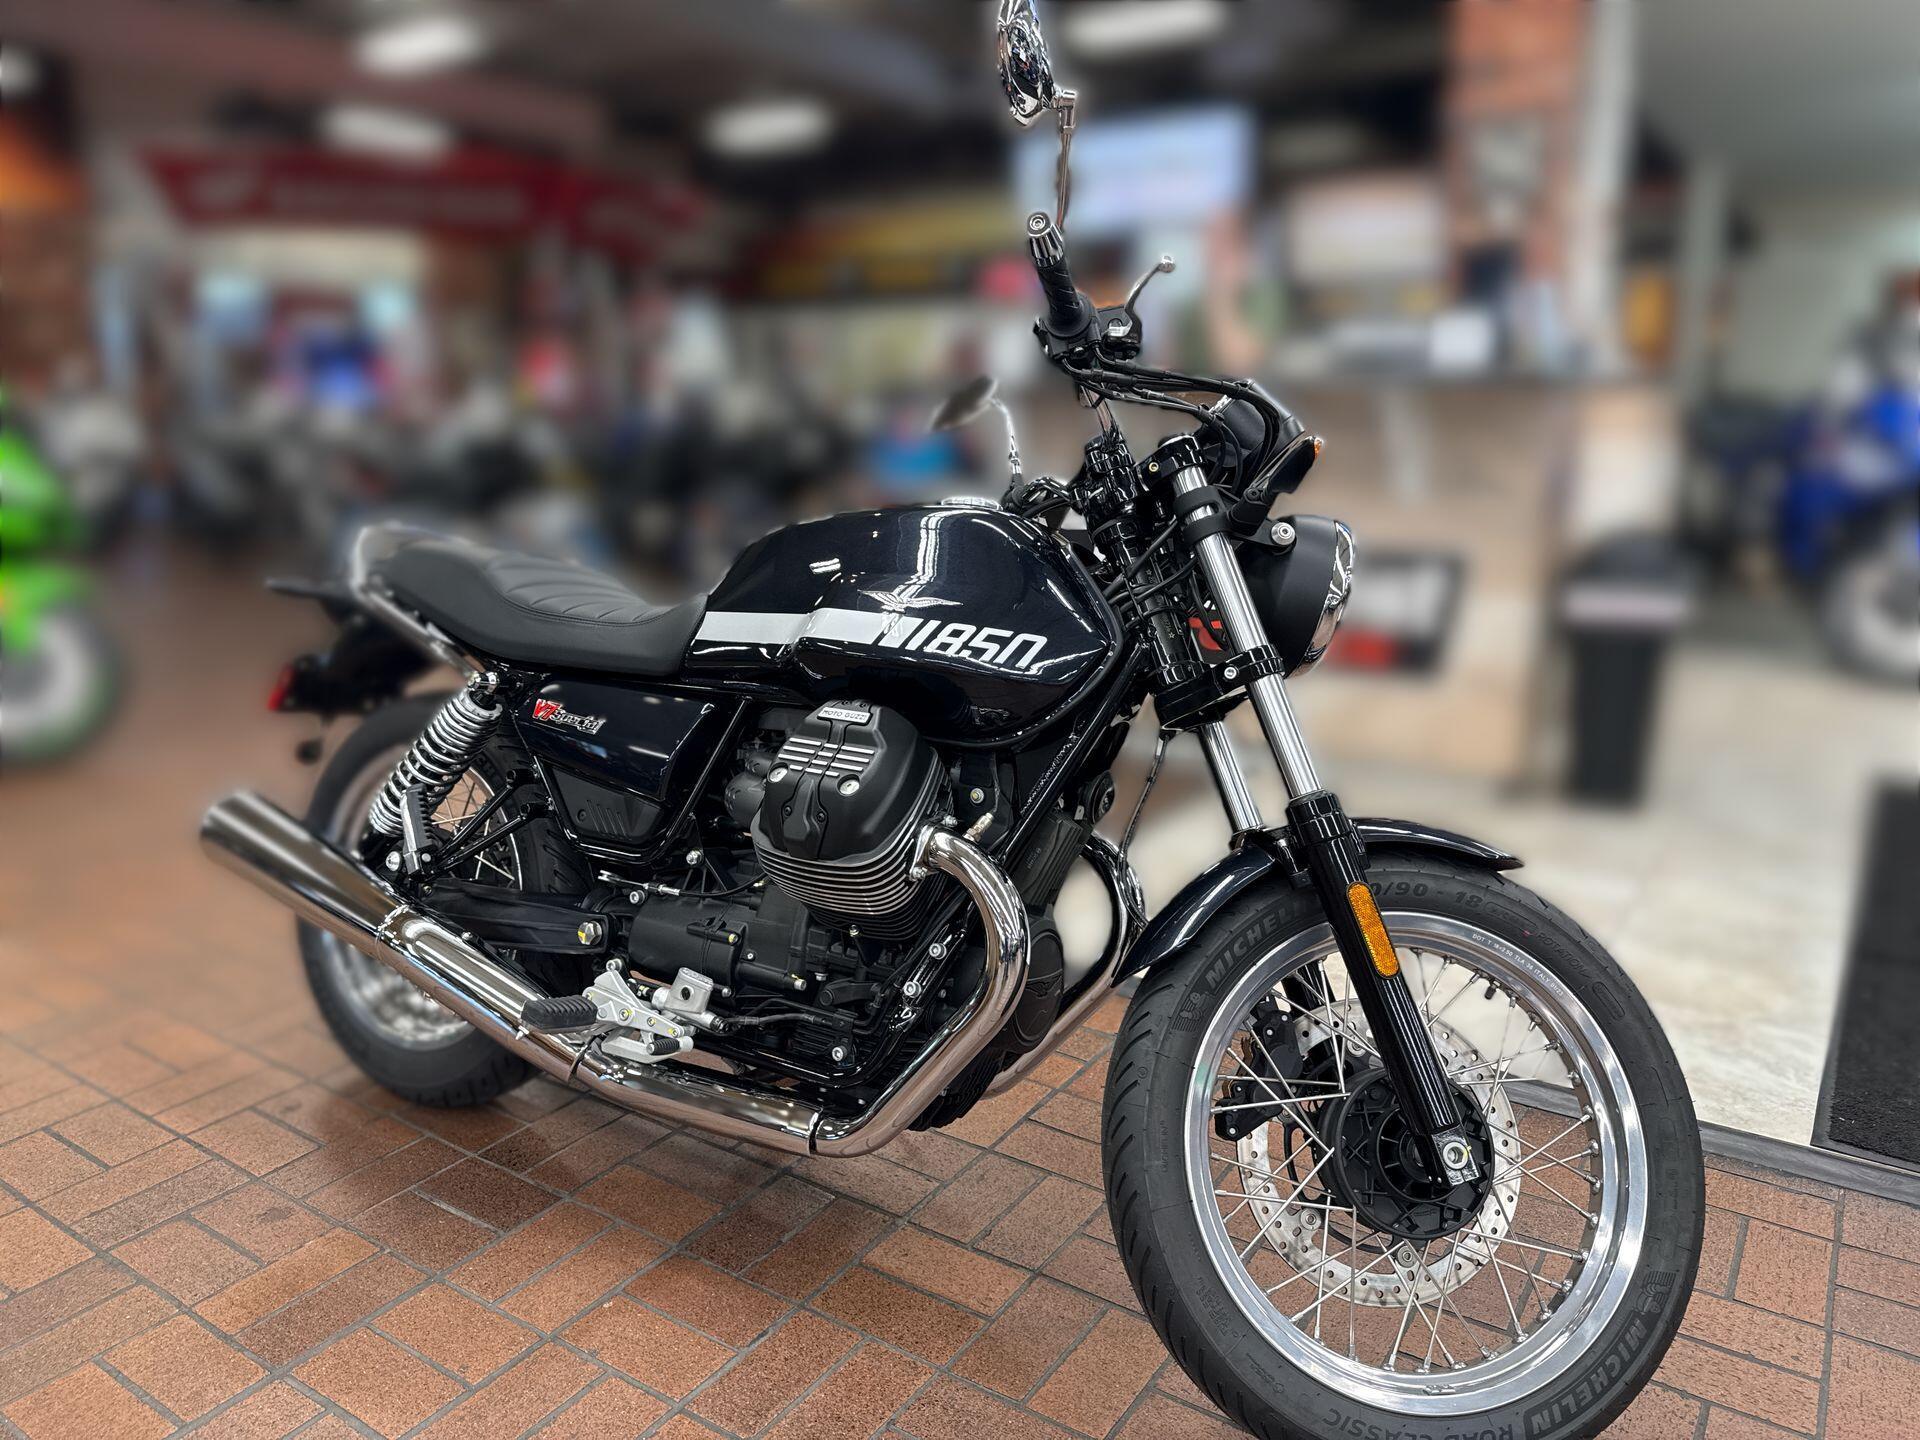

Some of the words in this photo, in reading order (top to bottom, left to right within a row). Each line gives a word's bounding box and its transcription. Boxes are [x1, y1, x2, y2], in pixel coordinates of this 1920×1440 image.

[532, 699, 562, 721] V7
[822, 709, 843, 717] MOTO
[1369, 880, 1428, 897] 0/90
[1454, 890, 1483, 908] 18
[1205, 905, 1297, 989] MICHEL
[1472, 933, 1486, 942] DOT
[1534, 968, 1549, 984] ITALY
[1531, 1319, 1648, 1435] MICHELIN
